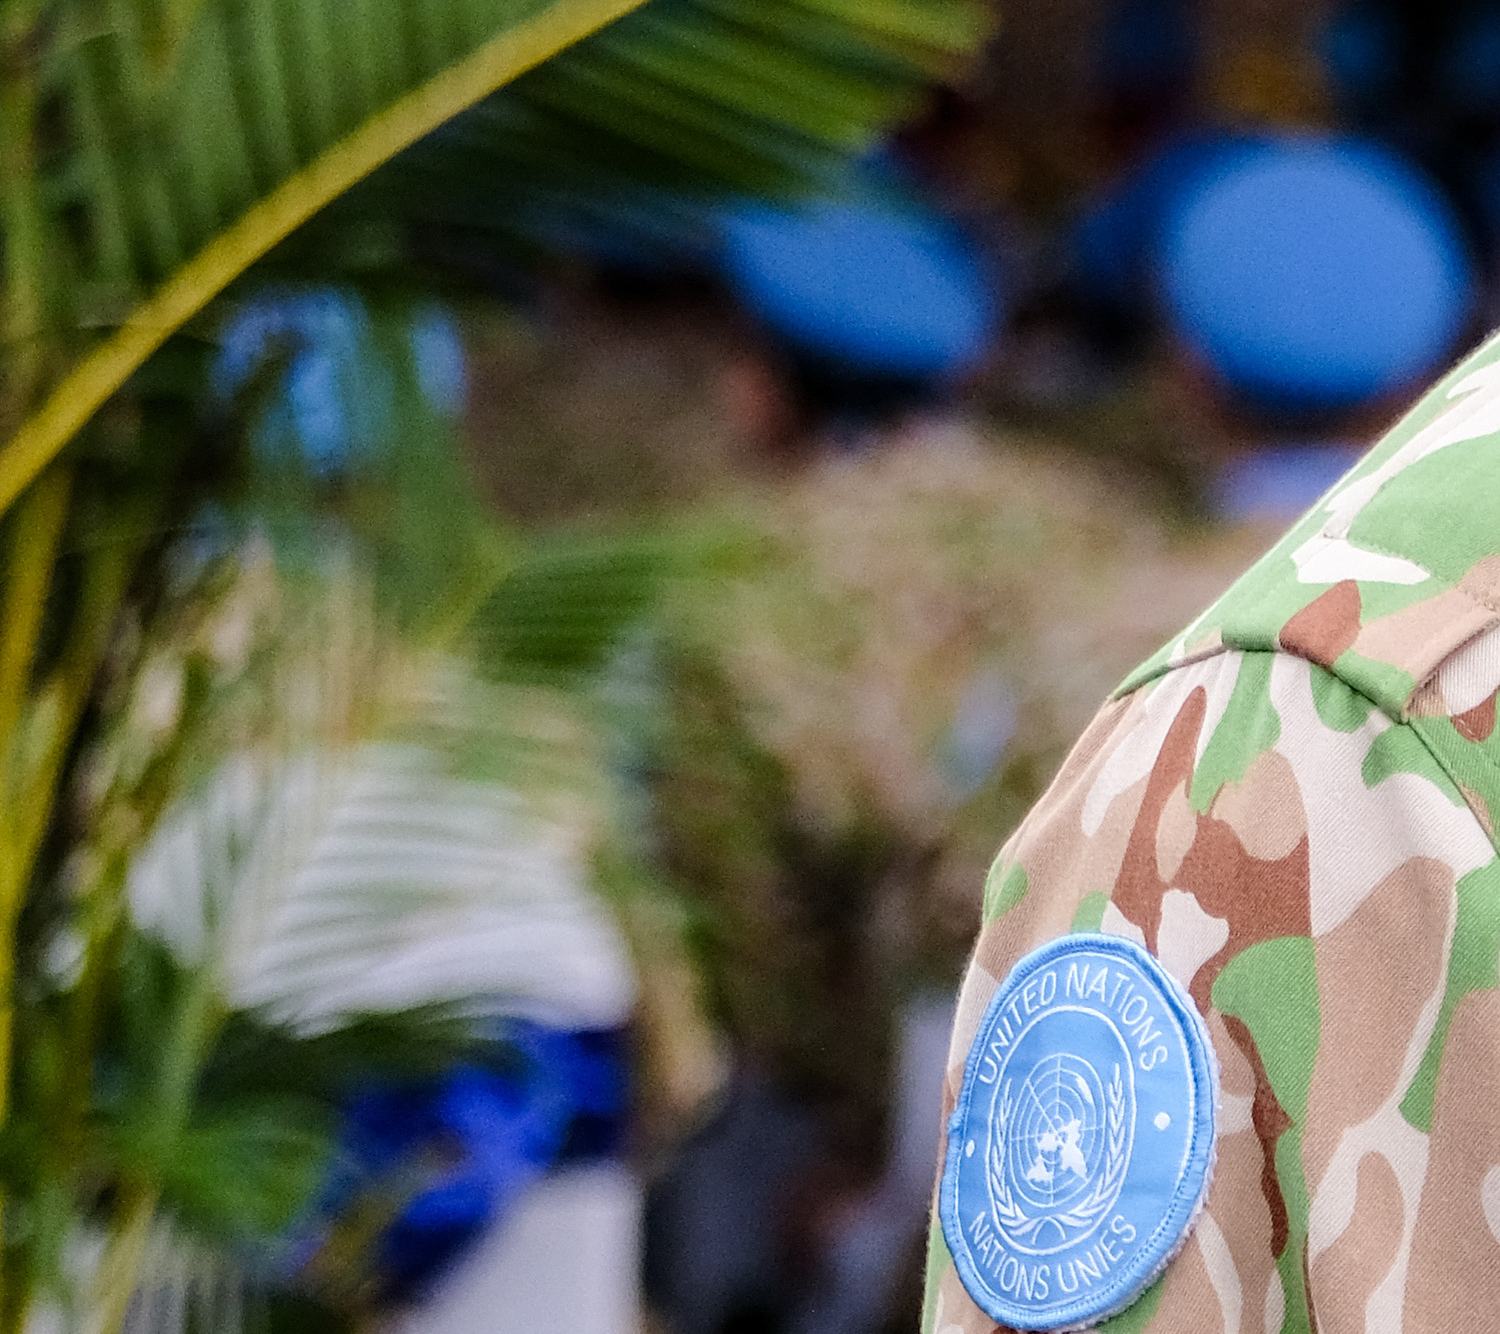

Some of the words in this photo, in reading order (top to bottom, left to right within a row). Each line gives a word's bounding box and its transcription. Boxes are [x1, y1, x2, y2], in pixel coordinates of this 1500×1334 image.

[978, 970, 1057, 1085] UNITED
[1065, 962, 1169, 1072] NATIONS
[968, 1210, 1050, 1302] NATIONS
[1058, 1213, 1137, 1293] UNIES
